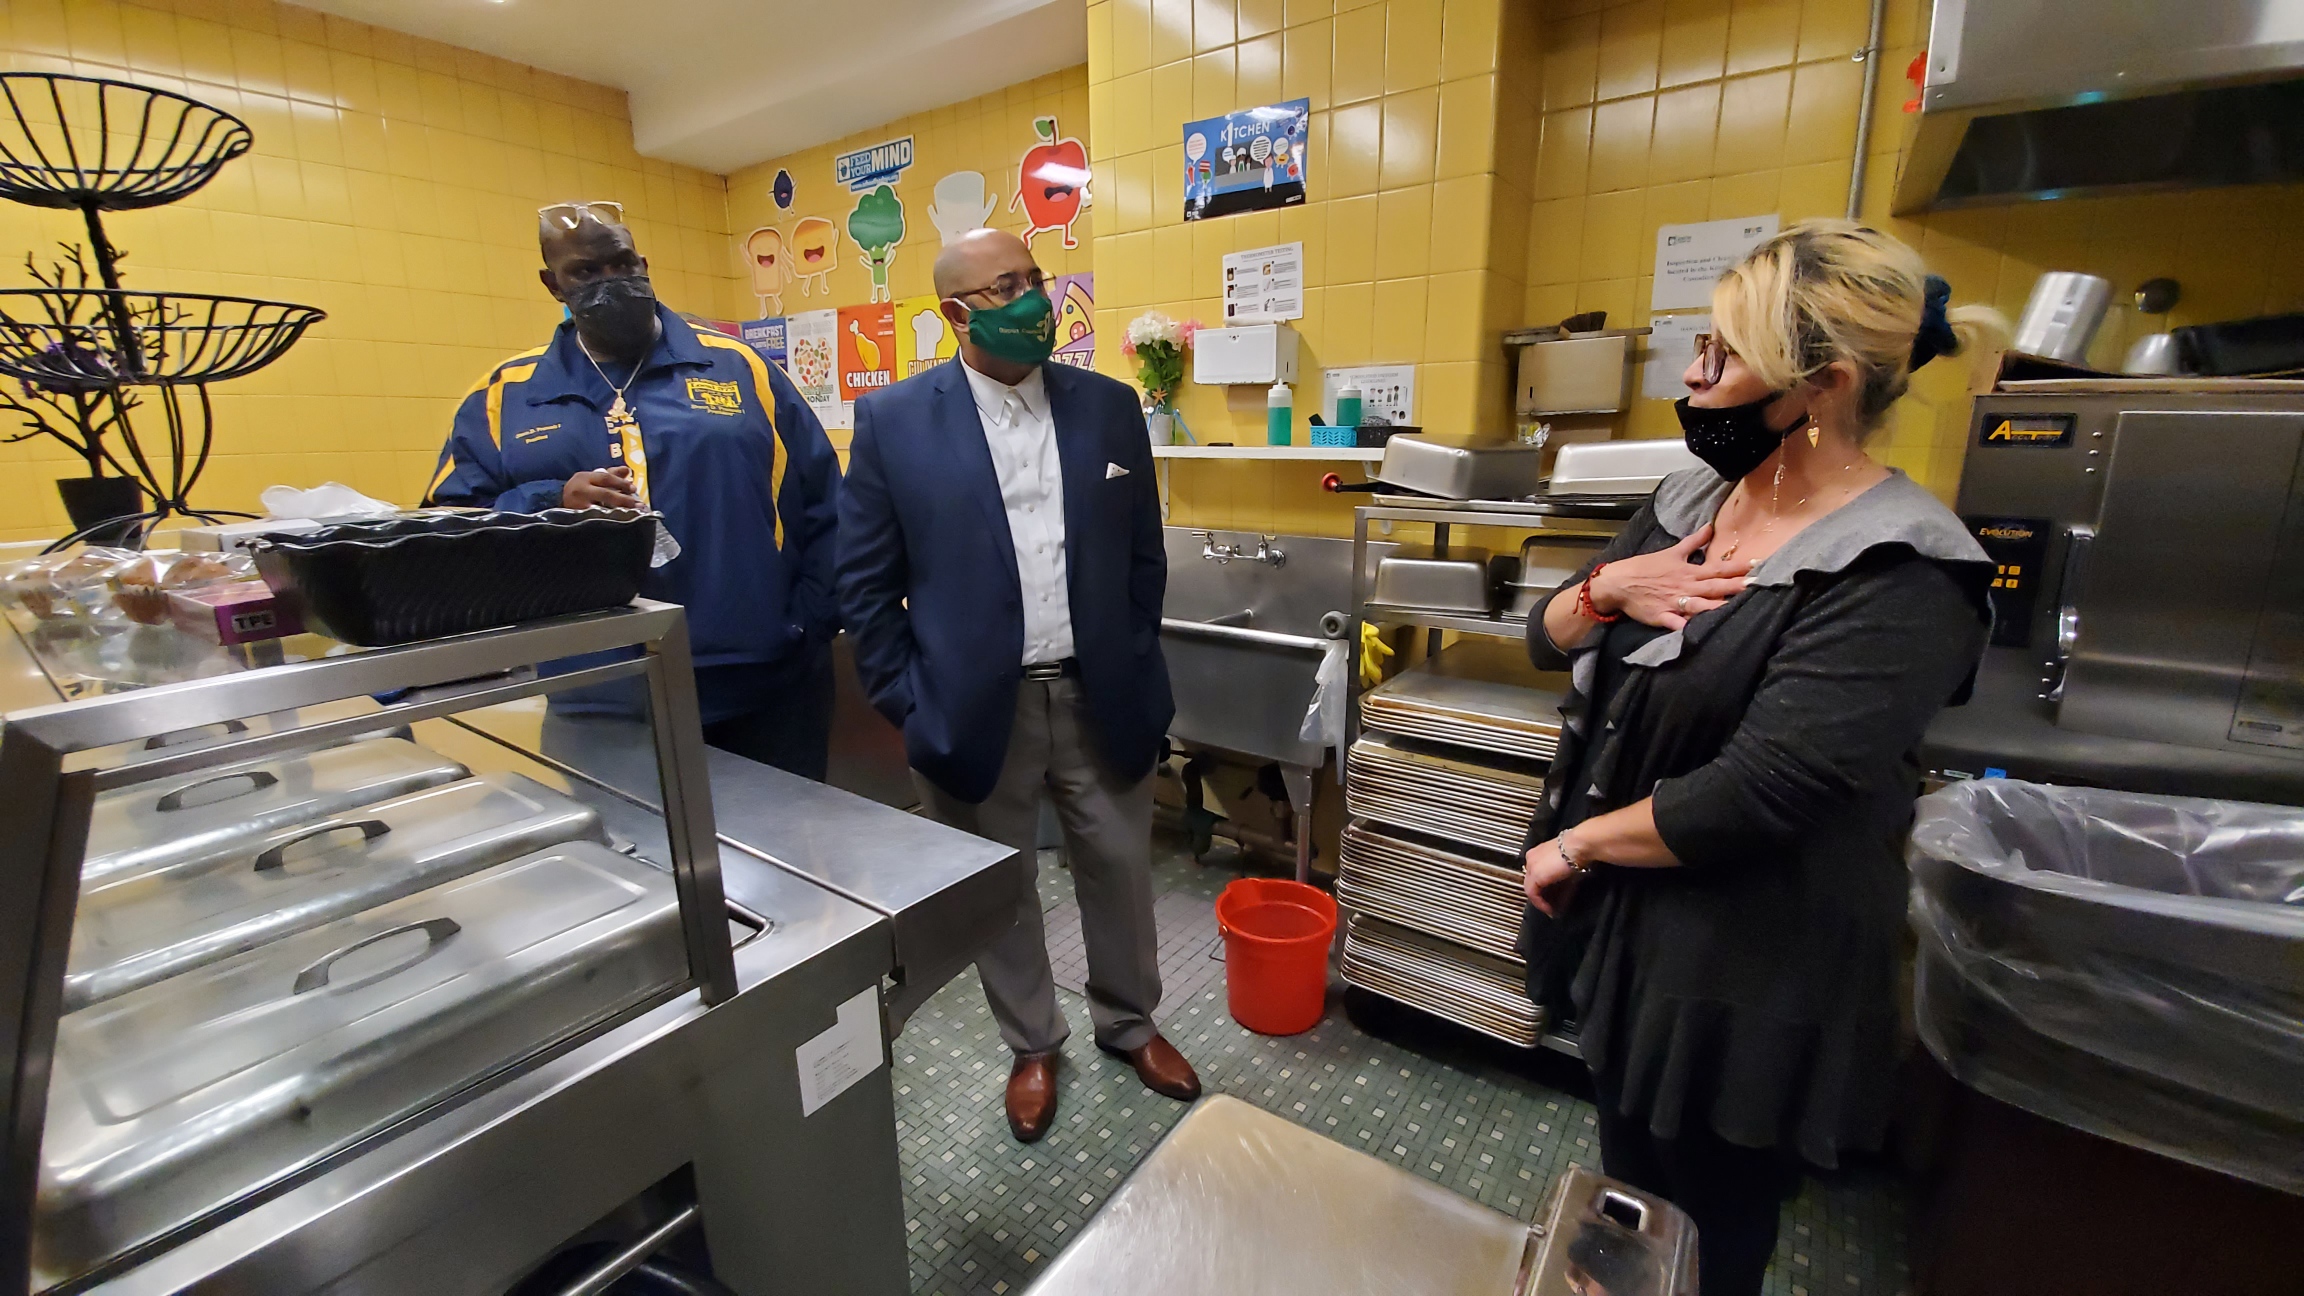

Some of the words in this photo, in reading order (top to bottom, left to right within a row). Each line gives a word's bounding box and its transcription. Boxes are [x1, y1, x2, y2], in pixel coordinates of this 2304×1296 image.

[850, 152, 871, 167] FEED
[872, 141, 911, 172] MIND
[851, 164, 872, 178] YOUR
[744, 325, 784, 340] BREAKFAST
[765, 337, 785, 350] FREE
[846, 370, 890, 388] CHICKEN
[1979, 527, 2034, 538] EVOLUTION
